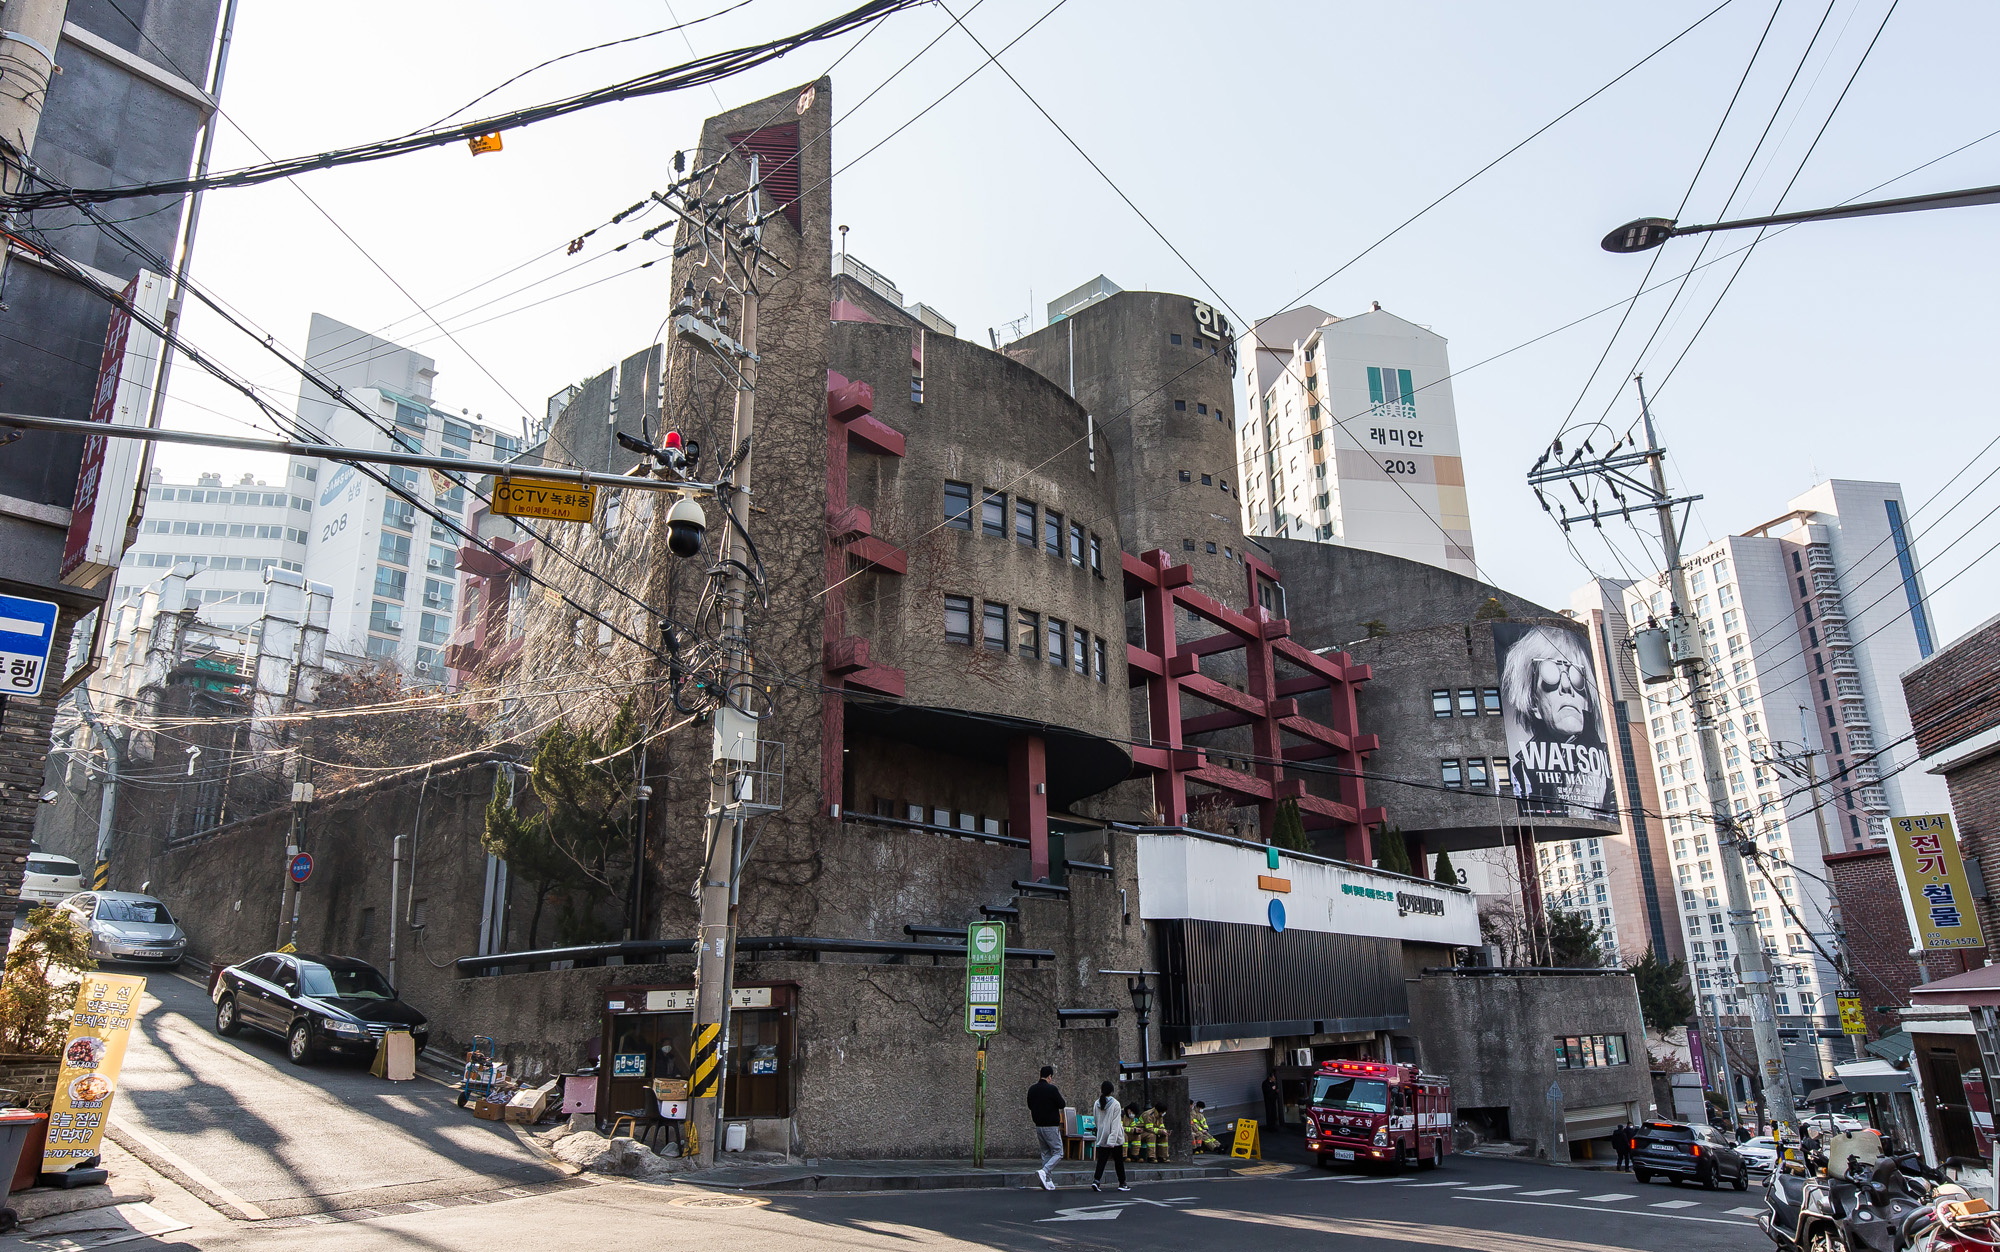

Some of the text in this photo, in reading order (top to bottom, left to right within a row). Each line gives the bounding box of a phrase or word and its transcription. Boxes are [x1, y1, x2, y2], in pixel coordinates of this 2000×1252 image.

[1370, 428, 1424, 447] 래미안
[1385, 459, 1417, 474] 203
[498, 488, 590, 508] CCTV 녹화중
[514, 505, 571, 518] (높이제한 4M)
[321, 513, 347, 543] 208
[0, 657, 38, 688] 행
[1536, 771, 1563, 784] THE
[1899, 816, 1945, 832] 영민사
[1929, 938, 1978, 946] 4276-1576
[986, 966, 995, 975] 17
[87, 1000, 130, 1016] 연중무휴
[74, 1013, 131, 1031] 단체석 완비
[50, 1111, 102, 1127] 오늘 점심
[1319, 1114, 1373, 1127] 서울 소방
[61, 1128, 93, 1143] 먹지?
